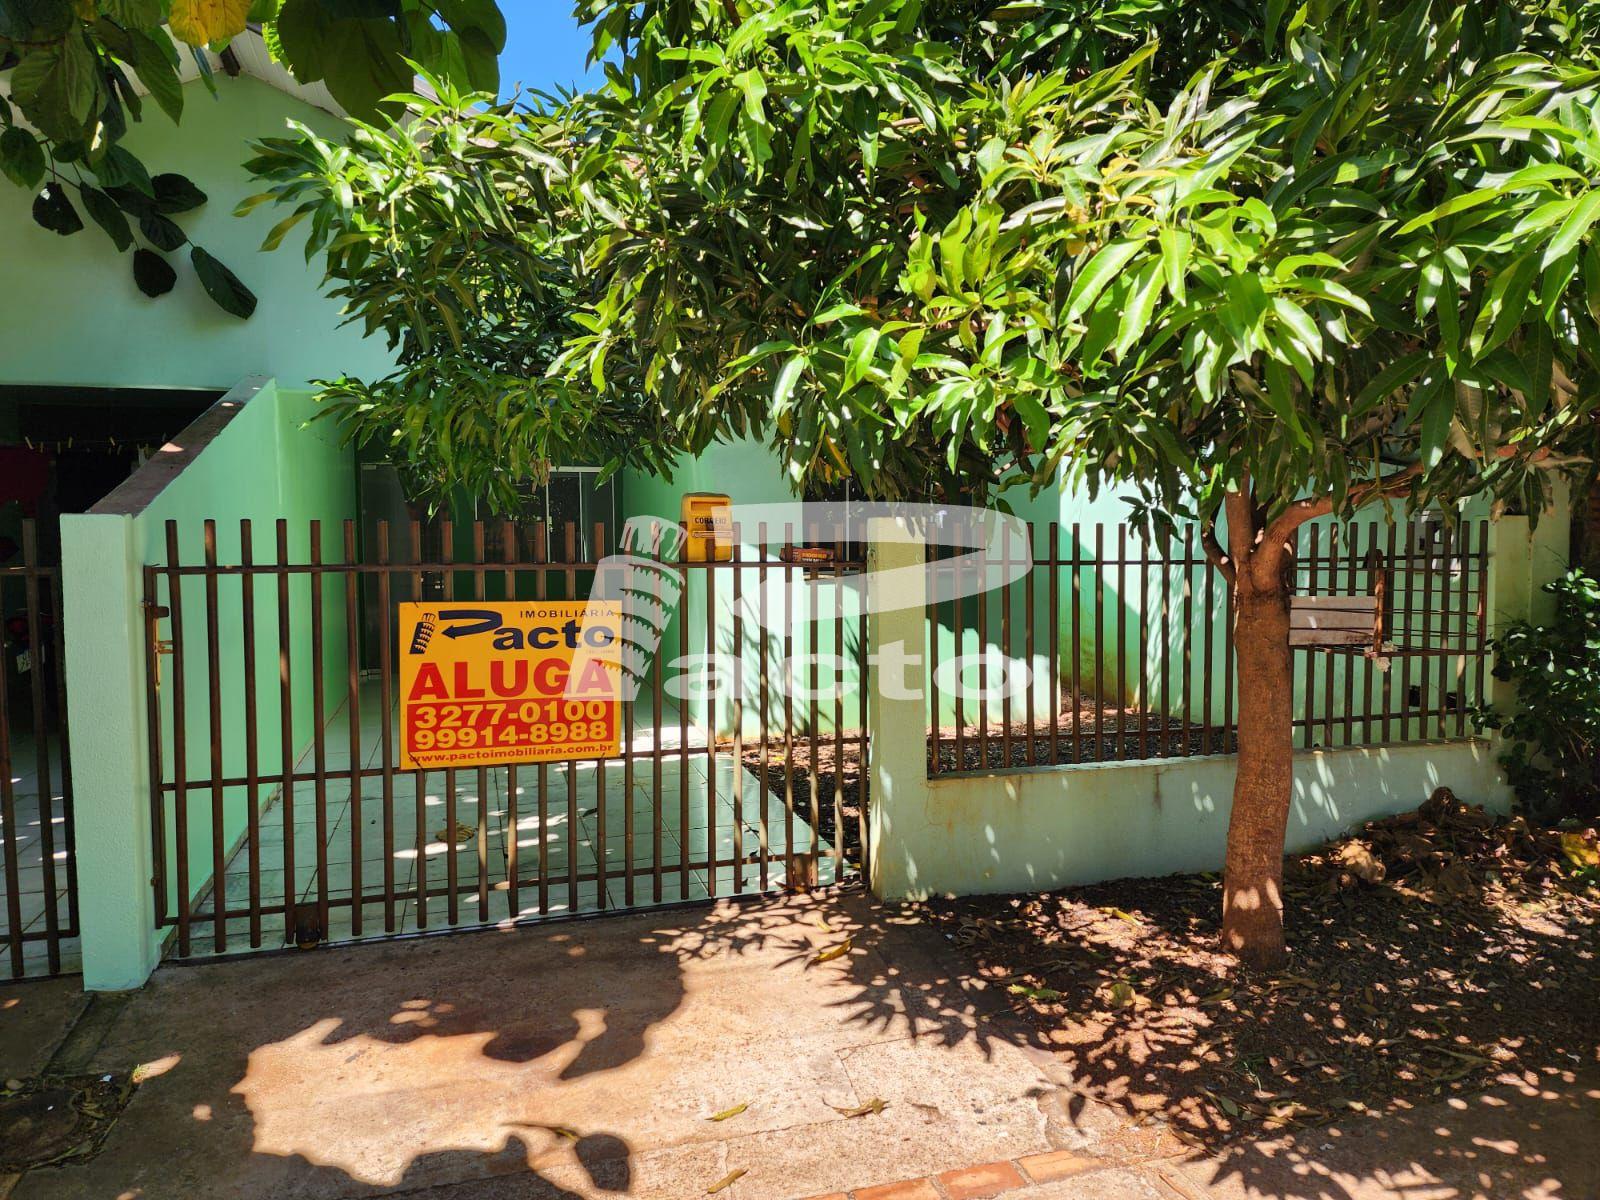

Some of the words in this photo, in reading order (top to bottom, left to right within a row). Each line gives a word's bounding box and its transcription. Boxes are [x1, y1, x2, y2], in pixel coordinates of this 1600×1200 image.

[407, 657, 614, 701] ALUGA
[414, 700, 607, 729] 3277-0100
[414, 721, 608, 750] 99914-8988
[408, 743, 614, 764] www.pactoimobiliaria.com.br
